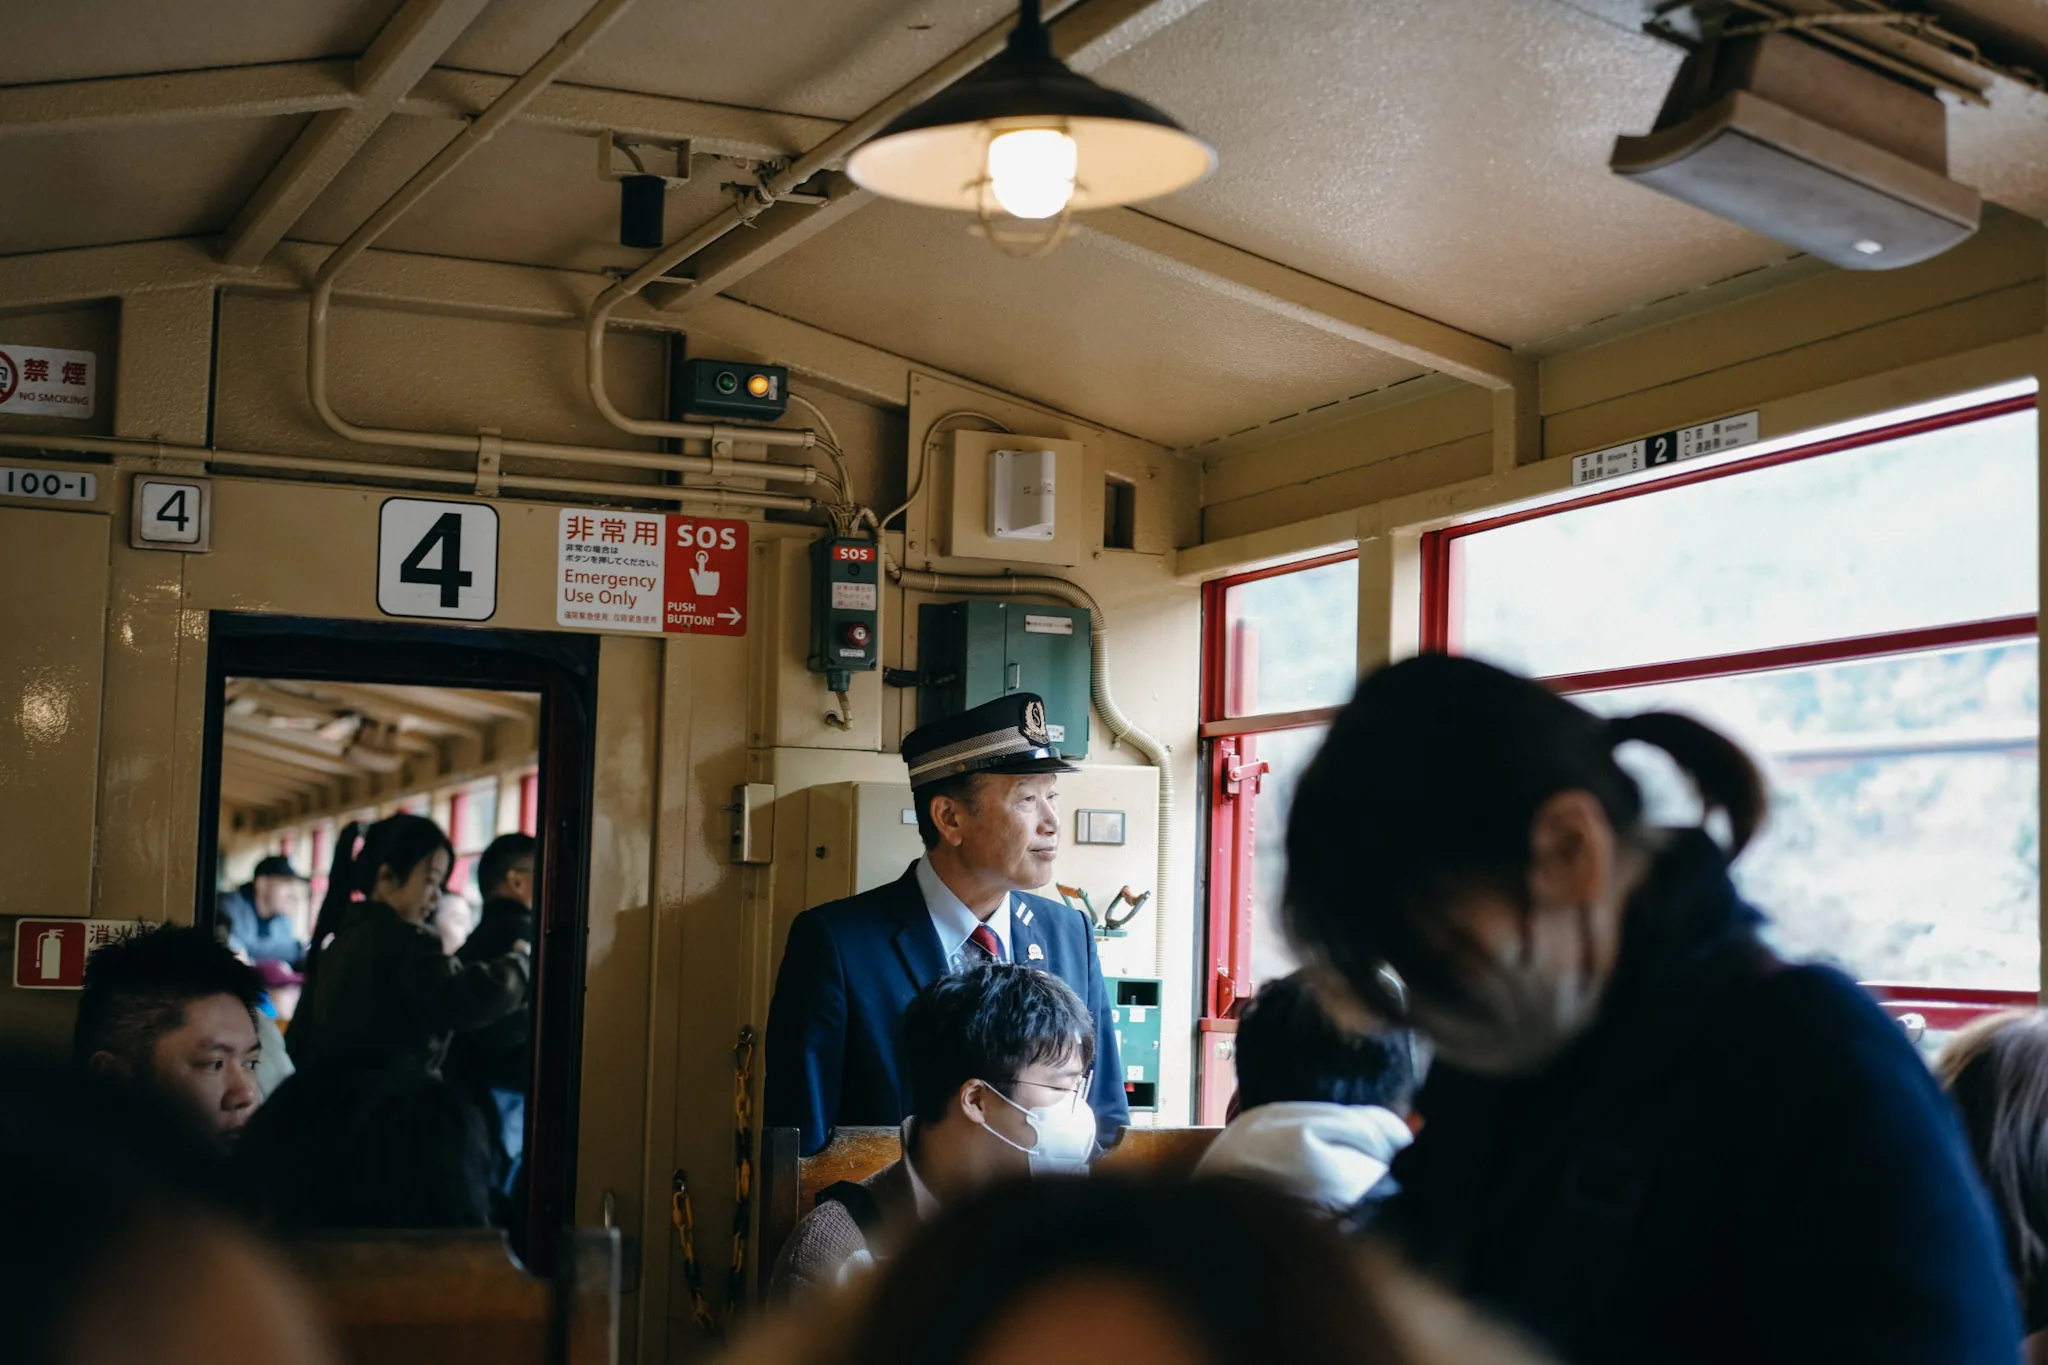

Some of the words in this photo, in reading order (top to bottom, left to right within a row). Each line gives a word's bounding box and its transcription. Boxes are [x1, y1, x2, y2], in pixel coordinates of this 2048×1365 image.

[24, 358, 87, 386] 禁煙
[19, 391, 36, 401] NO
[37, 393, 90, 406] SMOKING
[1684, 430, 1691, 442] D
[1632, 445, 1639, 456] A
[1654, 437, 1668, 464] 2
[1684, 444, 1691, 456] C
[8, 471, 86, 498] 100-1
[156, 490, 189, 532] 4
[566, 515, 659, 547] 非常用
[677, 524, 737, 551] SOS
[565, 543, 619, 555] 非常の場合は
[840, 548, 868, 560] SOS
[400, 512, 473, 608] 4
[565, 554, 659, 568] ボタンを押してください。
[565, 568, 657, 592] Emergency
[564, 587, 594, 604] Use
[598, 590, 638, 610] Only
[667, 601, 697, 613] PUSH
[667, 614, 715, 627] BUTTON!
[1032, 707, 1041, 726] S
